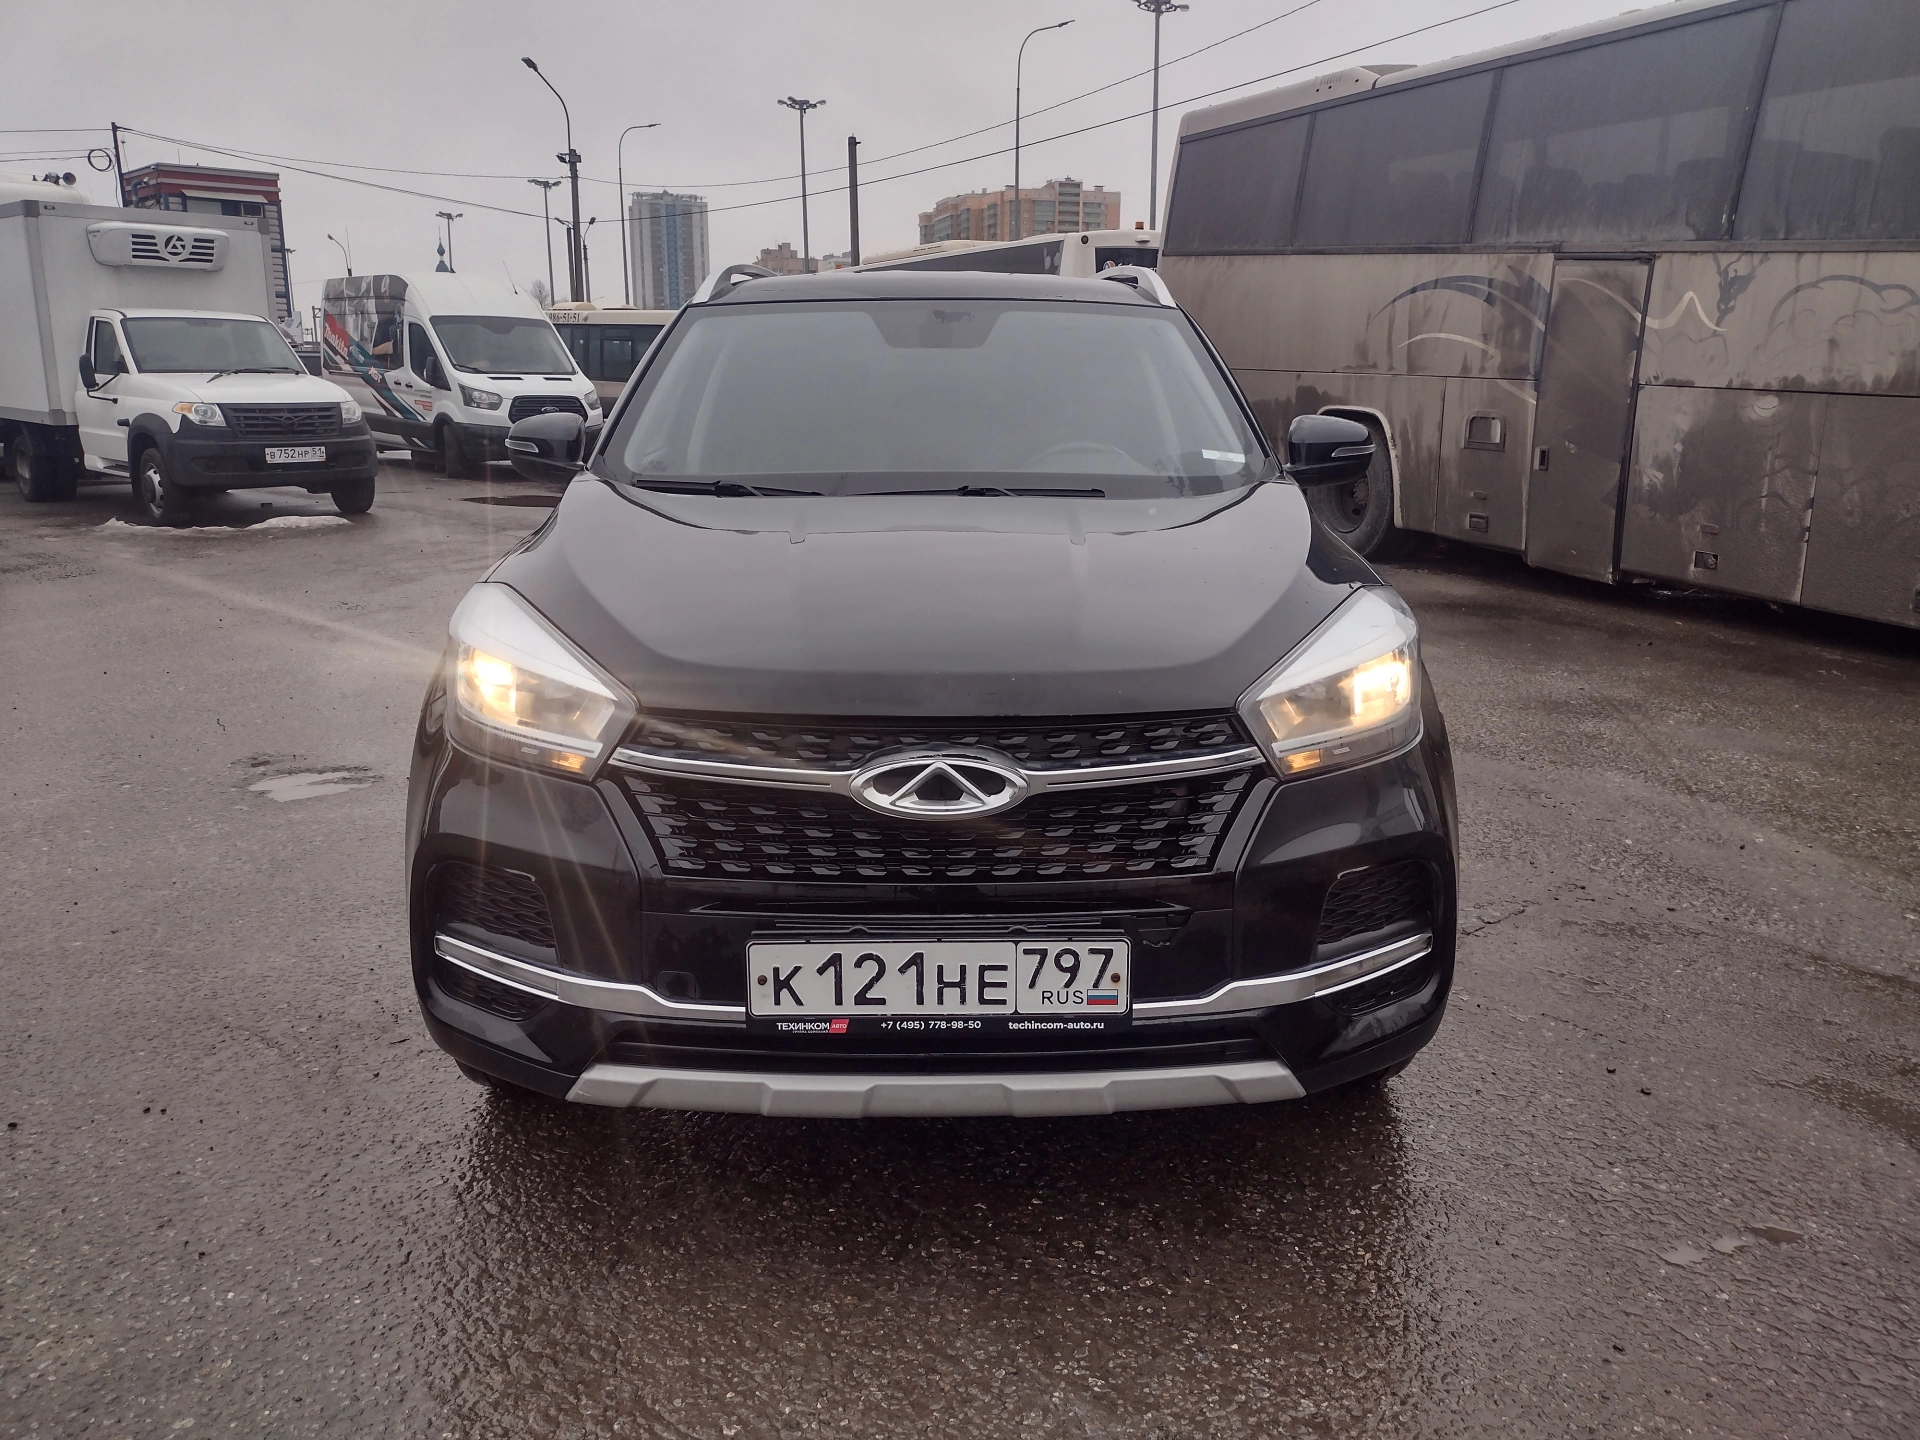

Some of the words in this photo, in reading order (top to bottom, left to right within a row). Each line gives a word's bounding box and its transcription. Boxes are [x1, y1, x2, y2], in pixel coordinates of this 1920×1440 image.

[324, 322, 350, 361] Makita
[270, 449, 309, 459] В752НР
[772, 951, 1009, 1006] К121НЕ
[1022, 947, 1115, 990] 797
[1041, 989, 1084, 1005] RUS
[776, 1022, 830, 1031] ТЕХИНКОМ
[881, 1021, 893, 1029] +7
[896, 1020, 925, 1030] (495)
[928, 1020, 982, 1029] 778-98-50
[1008, 1020, 1105, 1030] techincom-auto.ru
